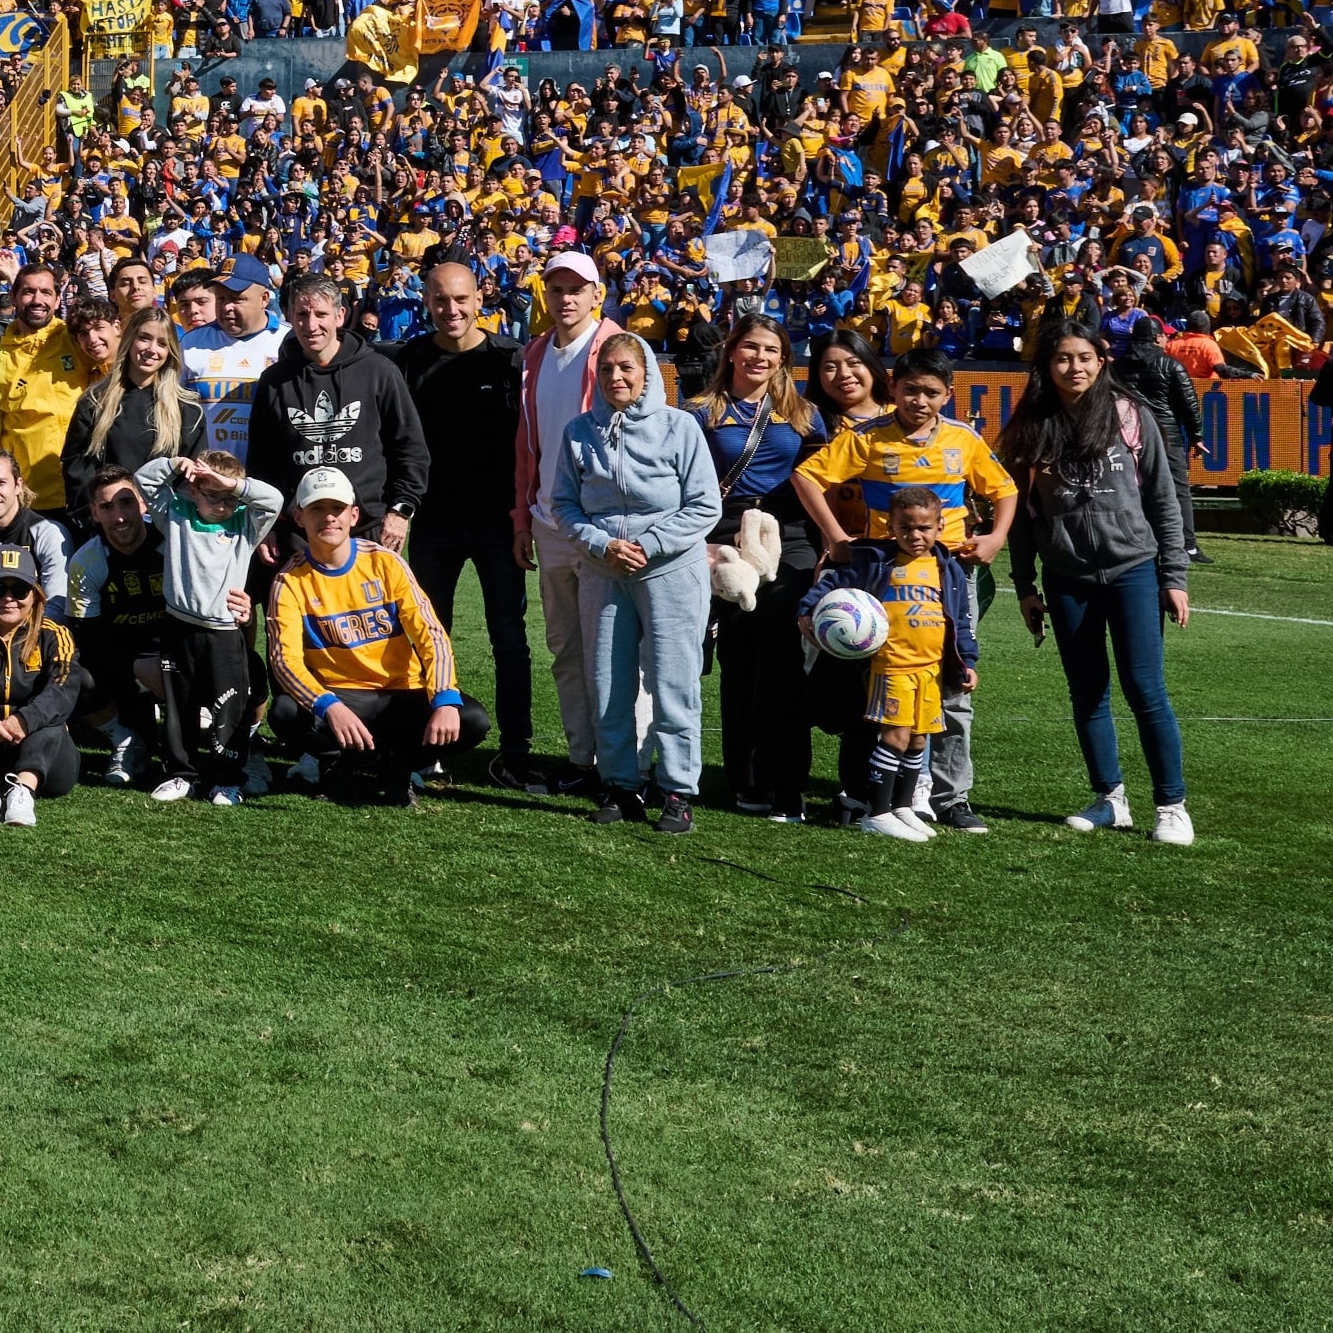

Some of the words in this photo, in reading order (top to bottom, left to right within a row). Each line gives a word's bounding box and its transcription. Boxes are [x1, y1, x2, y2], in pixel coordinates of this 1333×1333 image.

[293, 445, 363, 464] adidas
[1, 550, 21, 569] U
[361, 580, 383, 603] U
[319, 609, 393, 647] TIGRES
